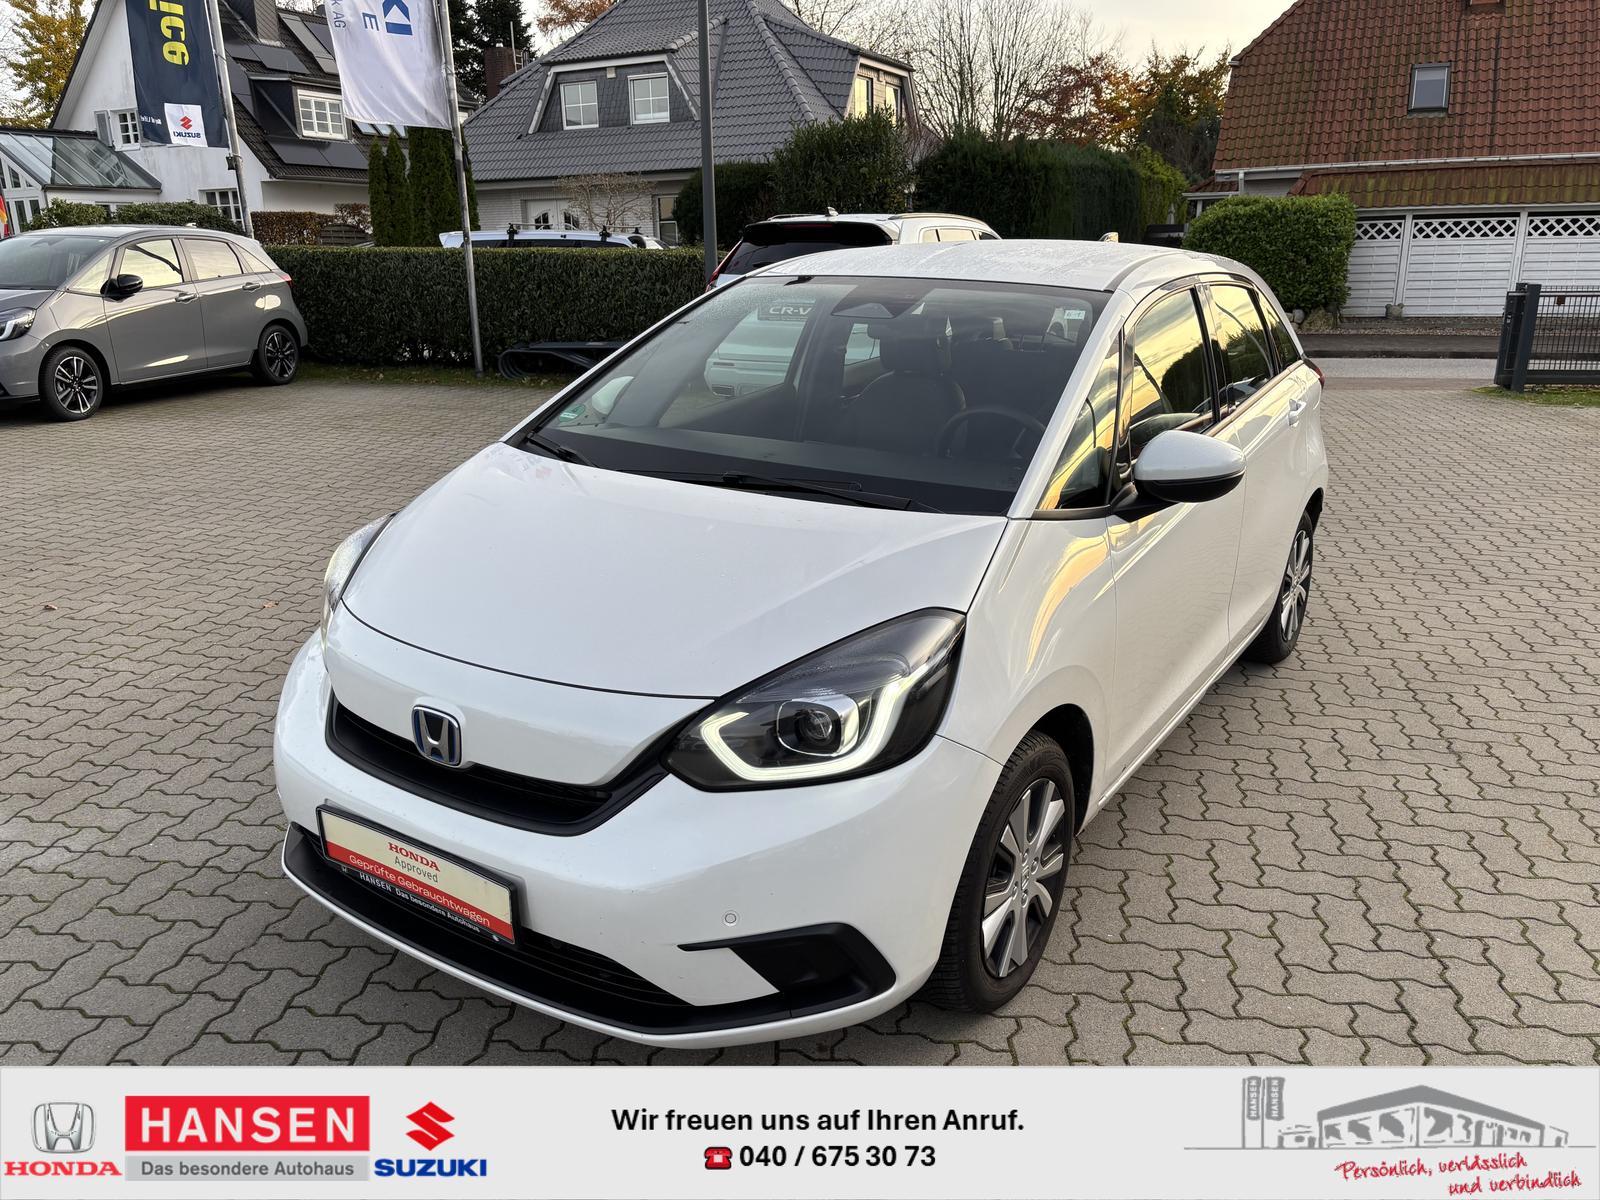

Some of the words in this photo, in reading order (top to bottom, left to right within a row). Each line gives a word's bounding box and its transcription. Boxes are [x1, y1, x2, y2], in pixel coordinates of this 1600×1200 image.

[332, 11, 347, 30] AG
[768, 306, 812, 315] CR-V
[387, 841, 441, 873] HONDA
[394, 855, 440, 884] Approved
[349, 854, 397, 882] Geprüfte
[397, 875, 492, 928] Gebrauchtwagen
[359, 871, 393, 893] HANSEN
[395, 887, 410, 901] Das
